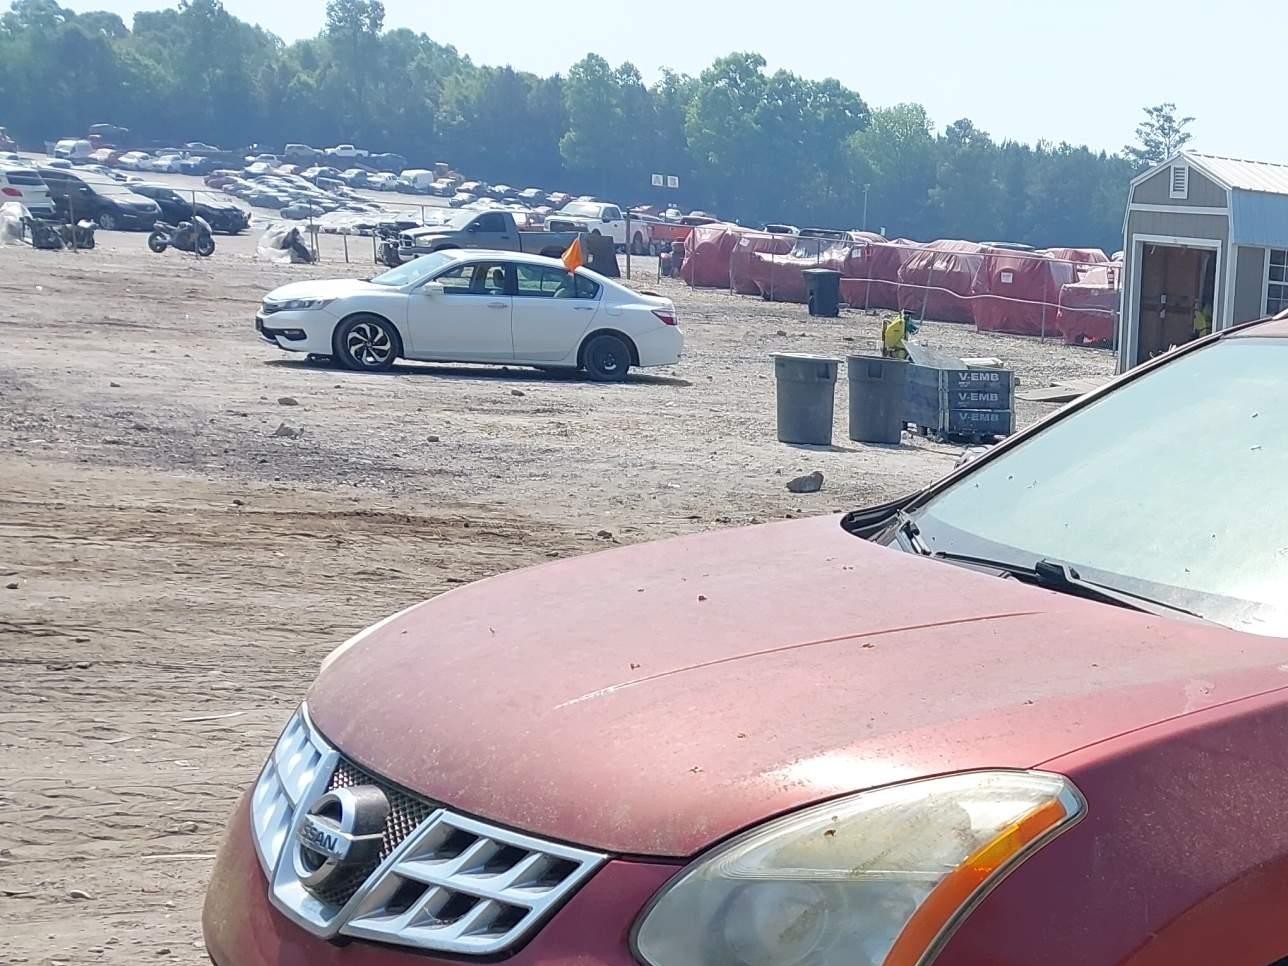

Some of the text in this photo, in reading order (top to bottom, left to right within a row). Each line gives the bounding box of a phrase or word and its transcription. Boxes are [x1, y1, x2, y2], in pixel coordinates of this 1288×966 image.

[958, 372, 999, 381] V-EMB
[958, 393, 999, 401] V-EMB
[959, 413, 1000, 421] V-EMB
[303, 823, 339, 851] SSAN
